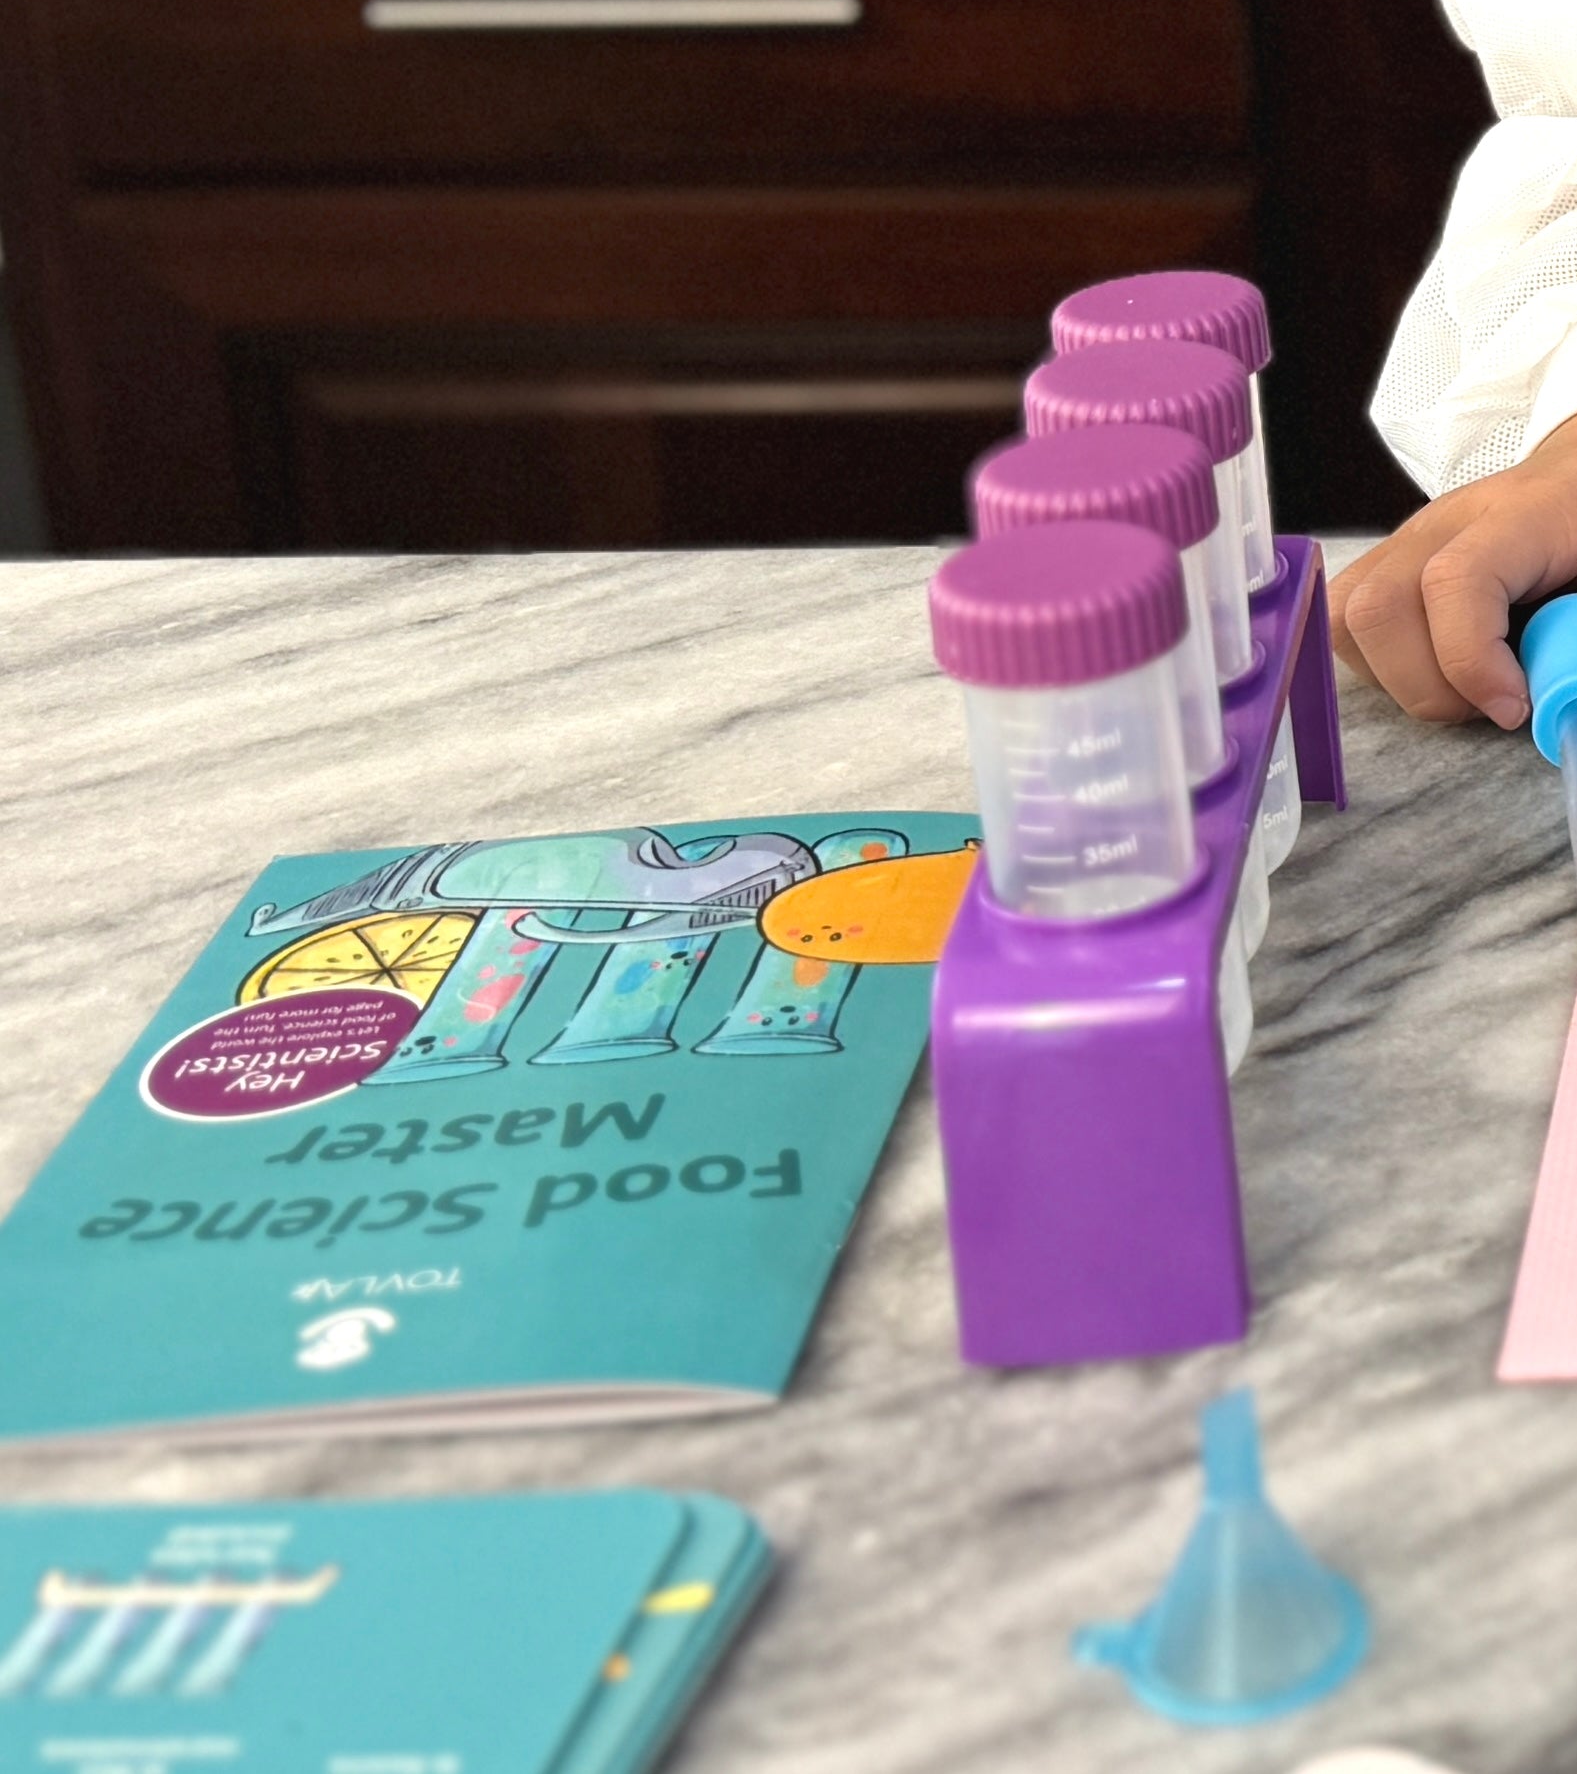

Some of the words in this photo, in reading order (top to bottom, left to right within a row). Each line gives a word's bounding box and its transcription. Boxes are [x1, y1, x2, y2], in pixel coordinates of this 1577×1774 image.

[1067, 727, 1122, 758] 45ml
[1073, 773, 1128, 803] 40ml
[1083, 833, 1138, 867] 35ml
[210, 1038, 256, 1051] world
[258, 1035, 284, 1047] the
[287, 1029, 343, 1043] explore
[174, 1040, 387, 1079] Scientists!
[224, 1070, 305, 1093] Hey
[264, 1092, 665, 1165] Master
[522, 1146, 801, 1228] Food
[77, 1181, 498, 1248] Science
